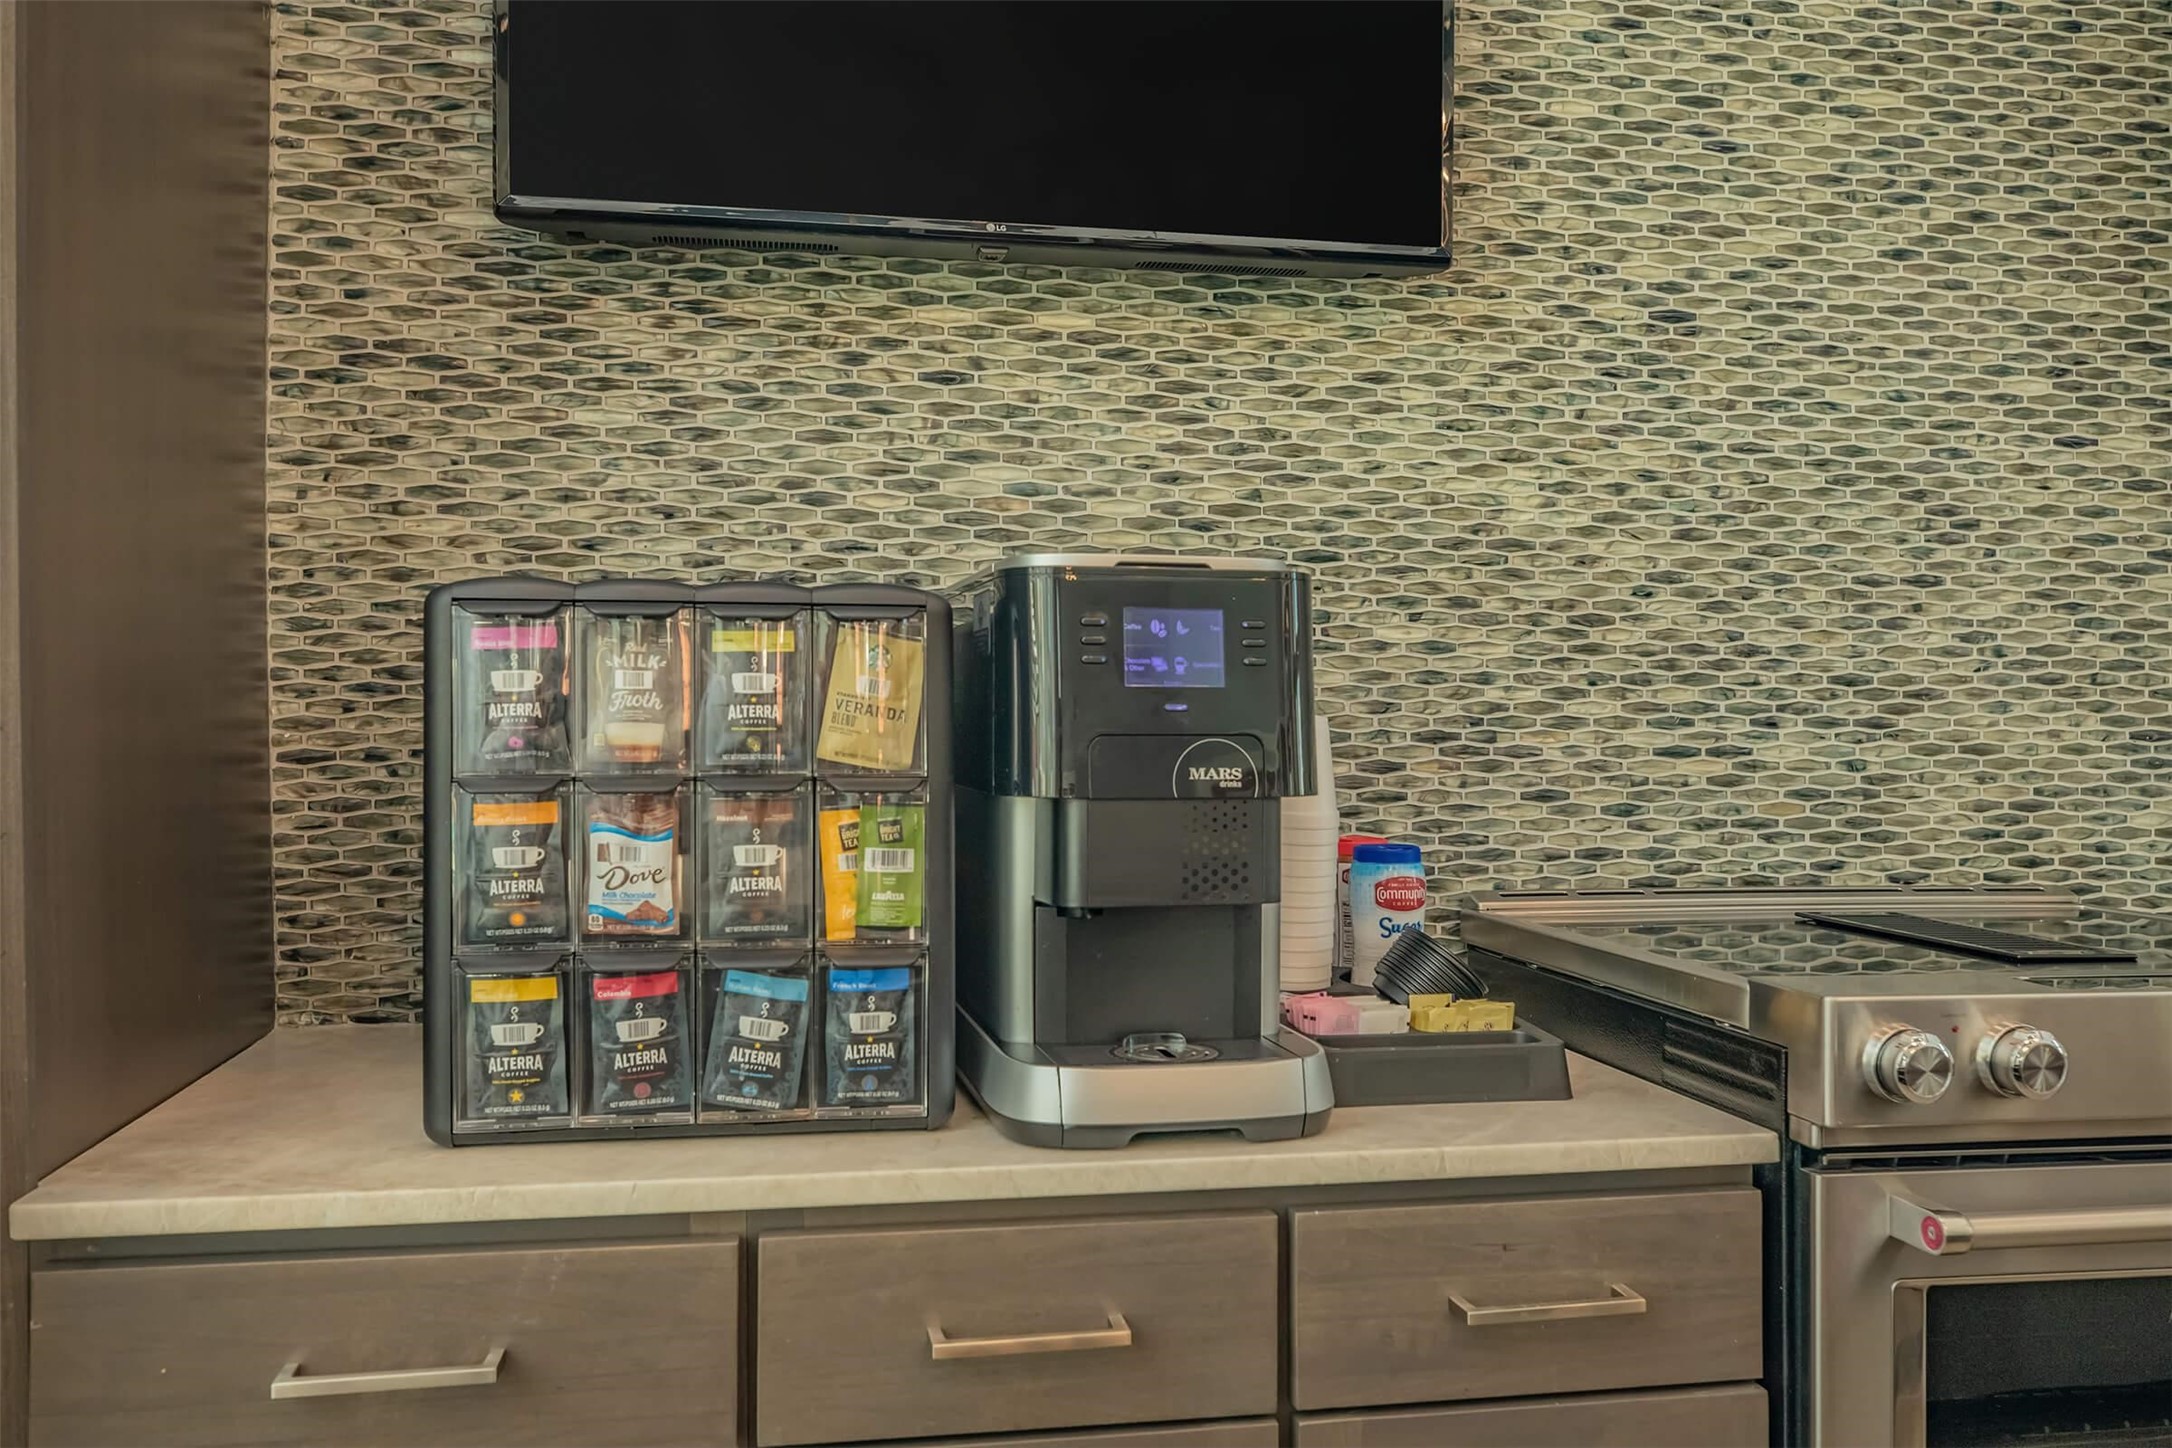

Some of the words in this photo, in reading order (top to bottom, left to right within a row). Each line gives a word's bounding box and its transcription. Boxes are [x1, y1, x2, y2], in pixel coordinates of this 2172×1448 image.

[996, 224, 1007, 232] LG
[612, 653, 661, 670] MILK
[608, 690, 664, 712] Froth
[488, 702, 542, 720] ALTERRA
[728, 703, 781, 720] ALTERRA
[831, 711, 857, 728] BLEND
[1188, 767, 1243, 780] MARS
[1219, 780, 1242, 788] drinks
[881, 833, 894, 841] TEA
[489, 878, 544, 896] ALTERRA
[596, 866, 667, 891] Dove
[729, 876, 782, 894] ALTERRA
[597, 988, 632, 998] Colombia
[614, 1047, 667, 1070] ALTERRA
[728, 1045, 781, 1069] ALTERRA
[844, 1042, 895, 1061] ALTERRA
[488, 1054, 543, 1074] ALTERRA
[627, 1064, 654, 1073] COFFEE
